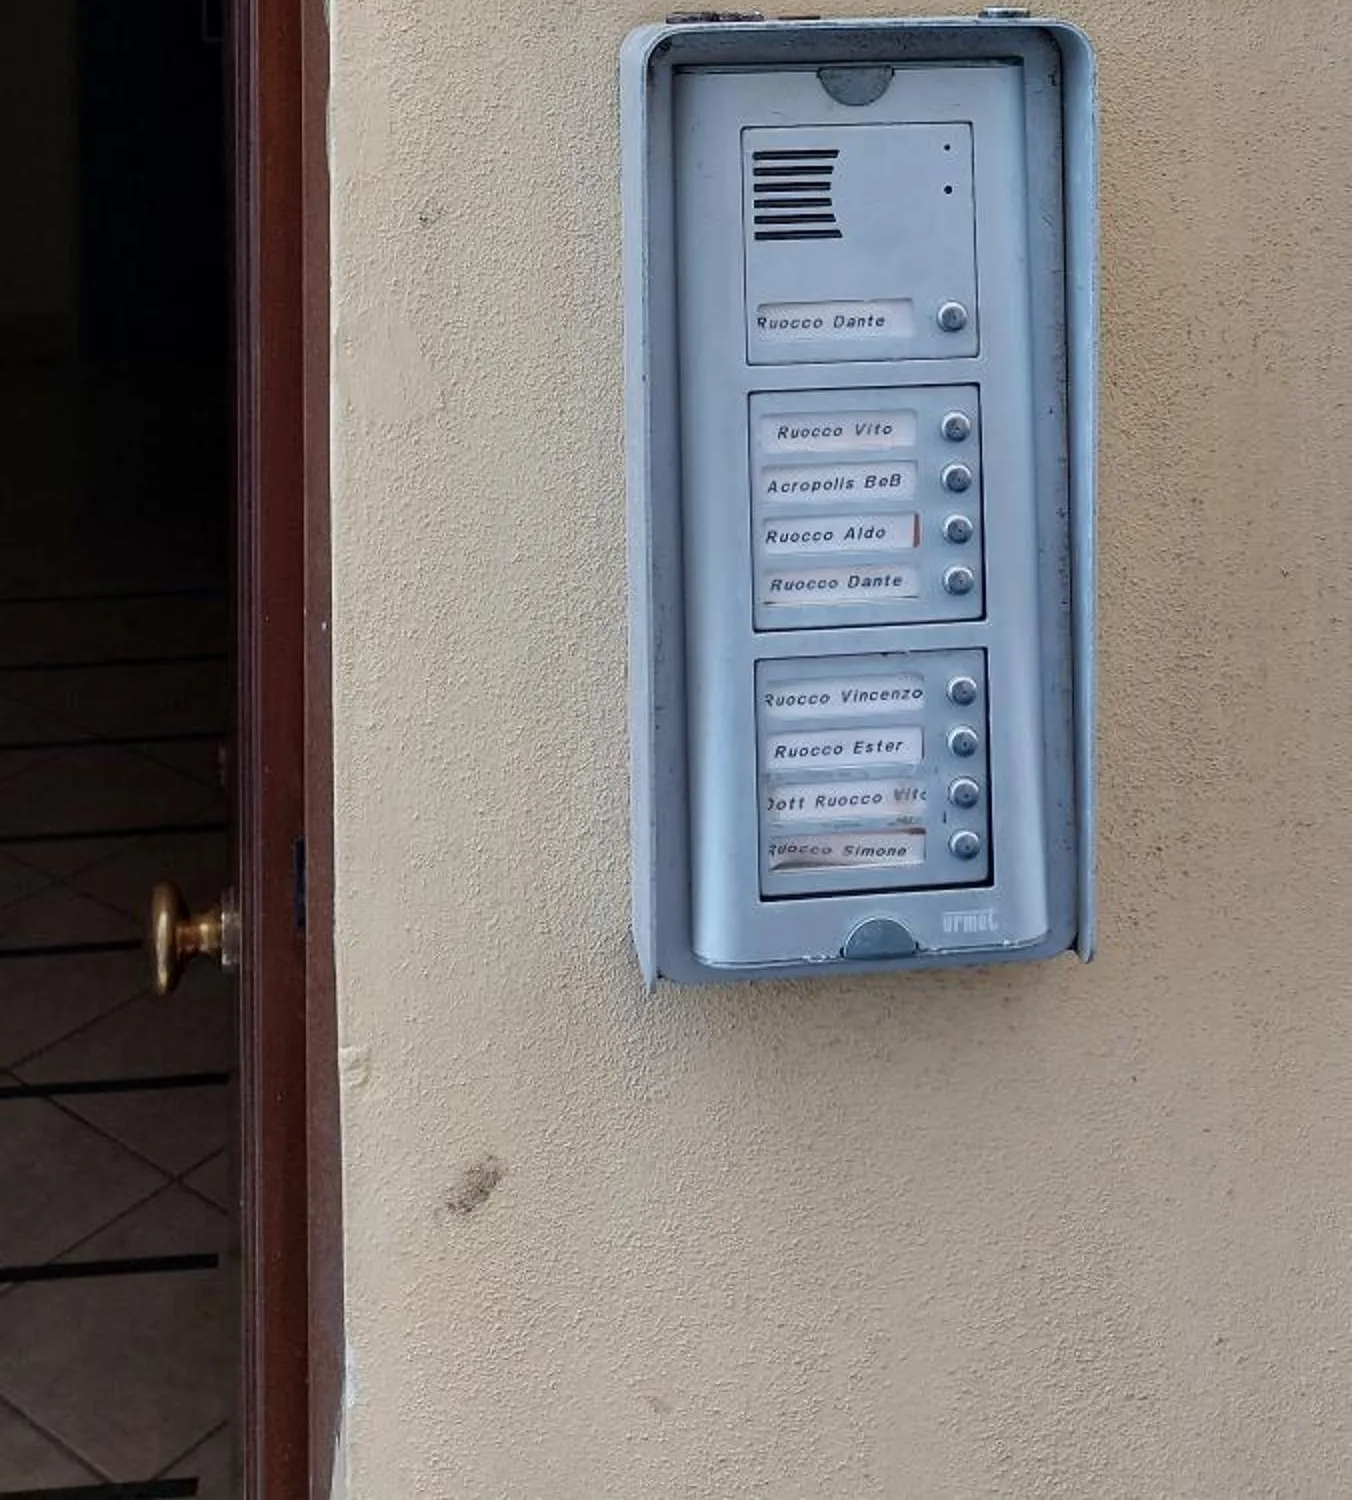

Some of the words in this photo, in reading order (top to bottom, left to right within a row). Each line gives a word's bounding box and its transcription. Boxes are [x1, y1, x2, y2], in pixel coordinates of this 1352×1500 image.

[757, 316, 824, 330] Ruocco
[833, 315, 886, 328] Dante
[777, 425, 844, 440] Ruocco
[855, 423, 893, 437] Vito
[767, 477, 855, 494] Acropolis
[765, 529, 833, 544] Ruocco
[844, 526, 887, 540] Aldo
[770, 578, 838, 592] Ruocco
[847, 575, 904, 589] Dante
[841, 689, 924, 703] Vincenzo
[774, 745, 843, 759] Ruocco
[853, 740, 904, 755] Ester
[815, 794, 883, 809] Ruocco
[842, 844, 908, 858] Simone
